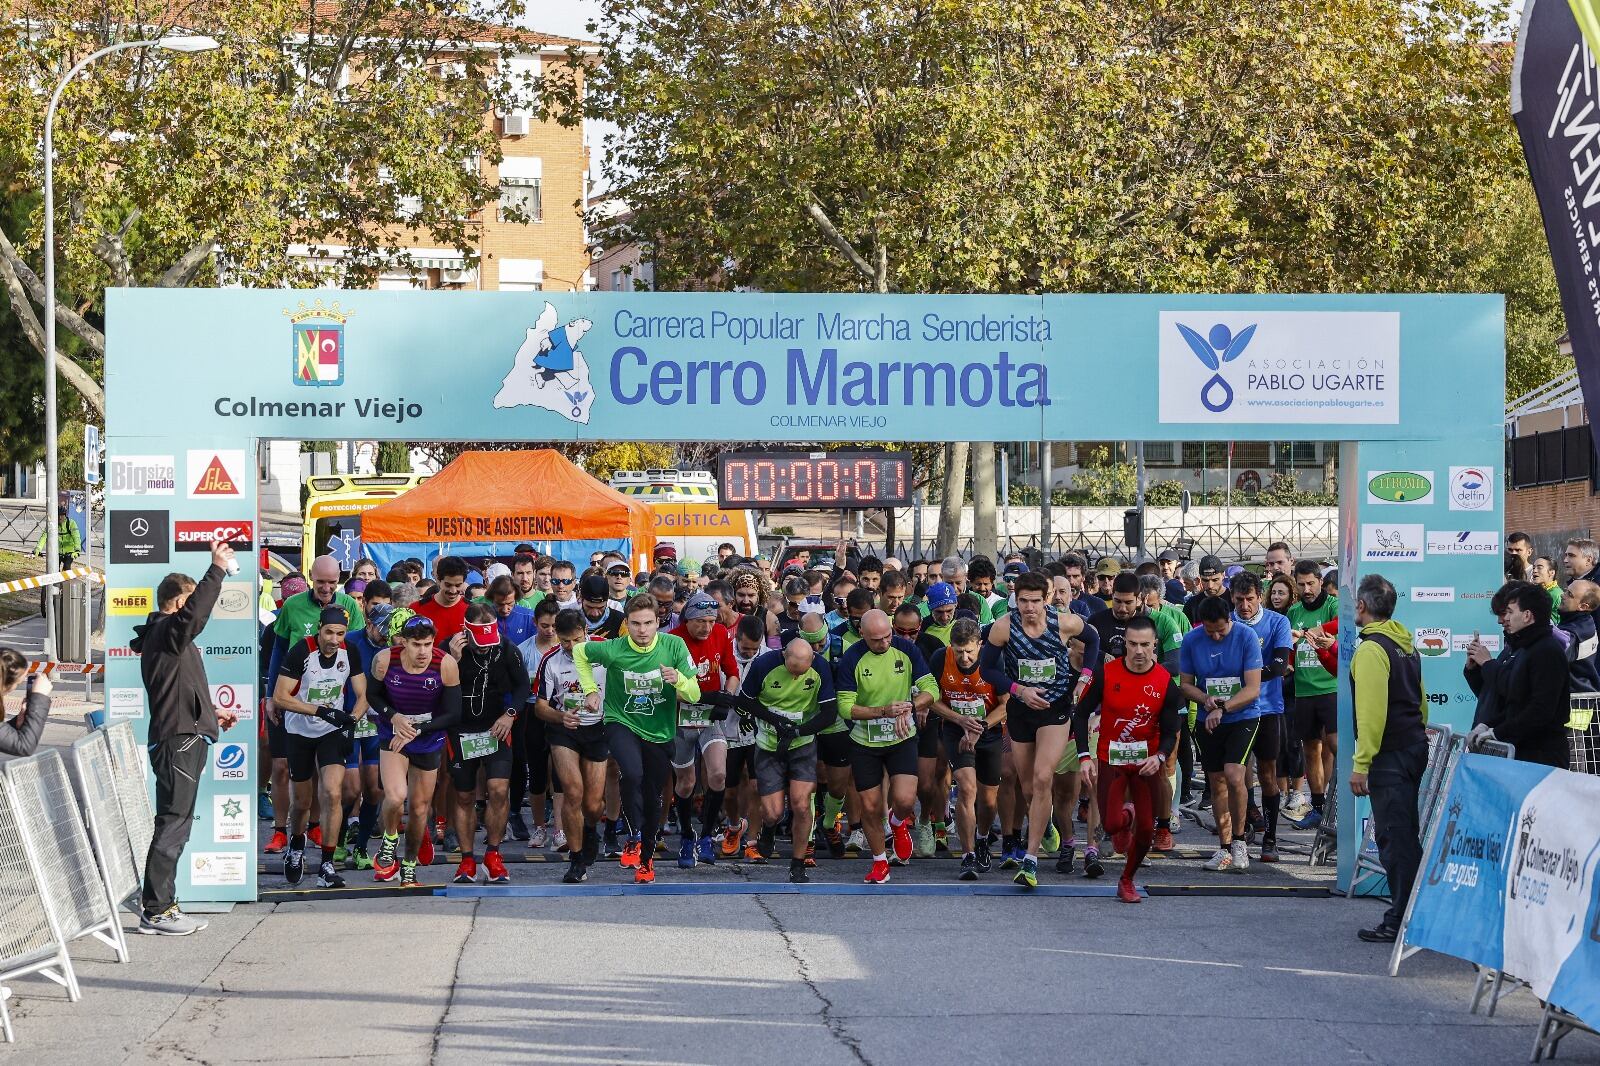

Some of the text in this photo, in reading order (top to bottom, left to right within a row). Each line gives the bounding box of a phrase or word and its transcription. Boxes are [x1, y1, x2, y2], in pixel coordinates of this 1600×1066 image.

[614, 309, 1052, 345] Carrera Popular Marcha Senderista
[1248, 357, 1385, 370] ASOCIACIÓN
[610, 346, 1052, 408] Cerro Marmota
[1248, 374, 1385, 391] PABLO UGARTE
[214, 397, 423, 424] Colmenar Viejo
[1247, 399, 1385, 409] www.asociacionpablougarte.es
[770, 415, 887, 428] COLMENAR VIEJO
[111, 461, 148, 495] Big
[147, 464, 174, 479] size
[147, 478, 175, 489] media
[727, 460, 905, 501] 00:00:01
[319, 503, 362, 512] PROTECCIÓN
[427, 516, 564, 537] PUESTO DE ASISTENCIA
[655, 513, 731, 527] OGISTICA
[1427, 542, 1500, 551] Ferbocar
[205, 645, 252, 655] amazon
[1030, 666, 1044, 674] 55
[690, 710, 704, 719] 87
[222, 770, 244, 778] ASD
[1451, 827, 1485, 860] Colmenar
[1526, 838, 1579, 891] Colmenar Viejo
[1442, 861, 1479, 892] me gusta
